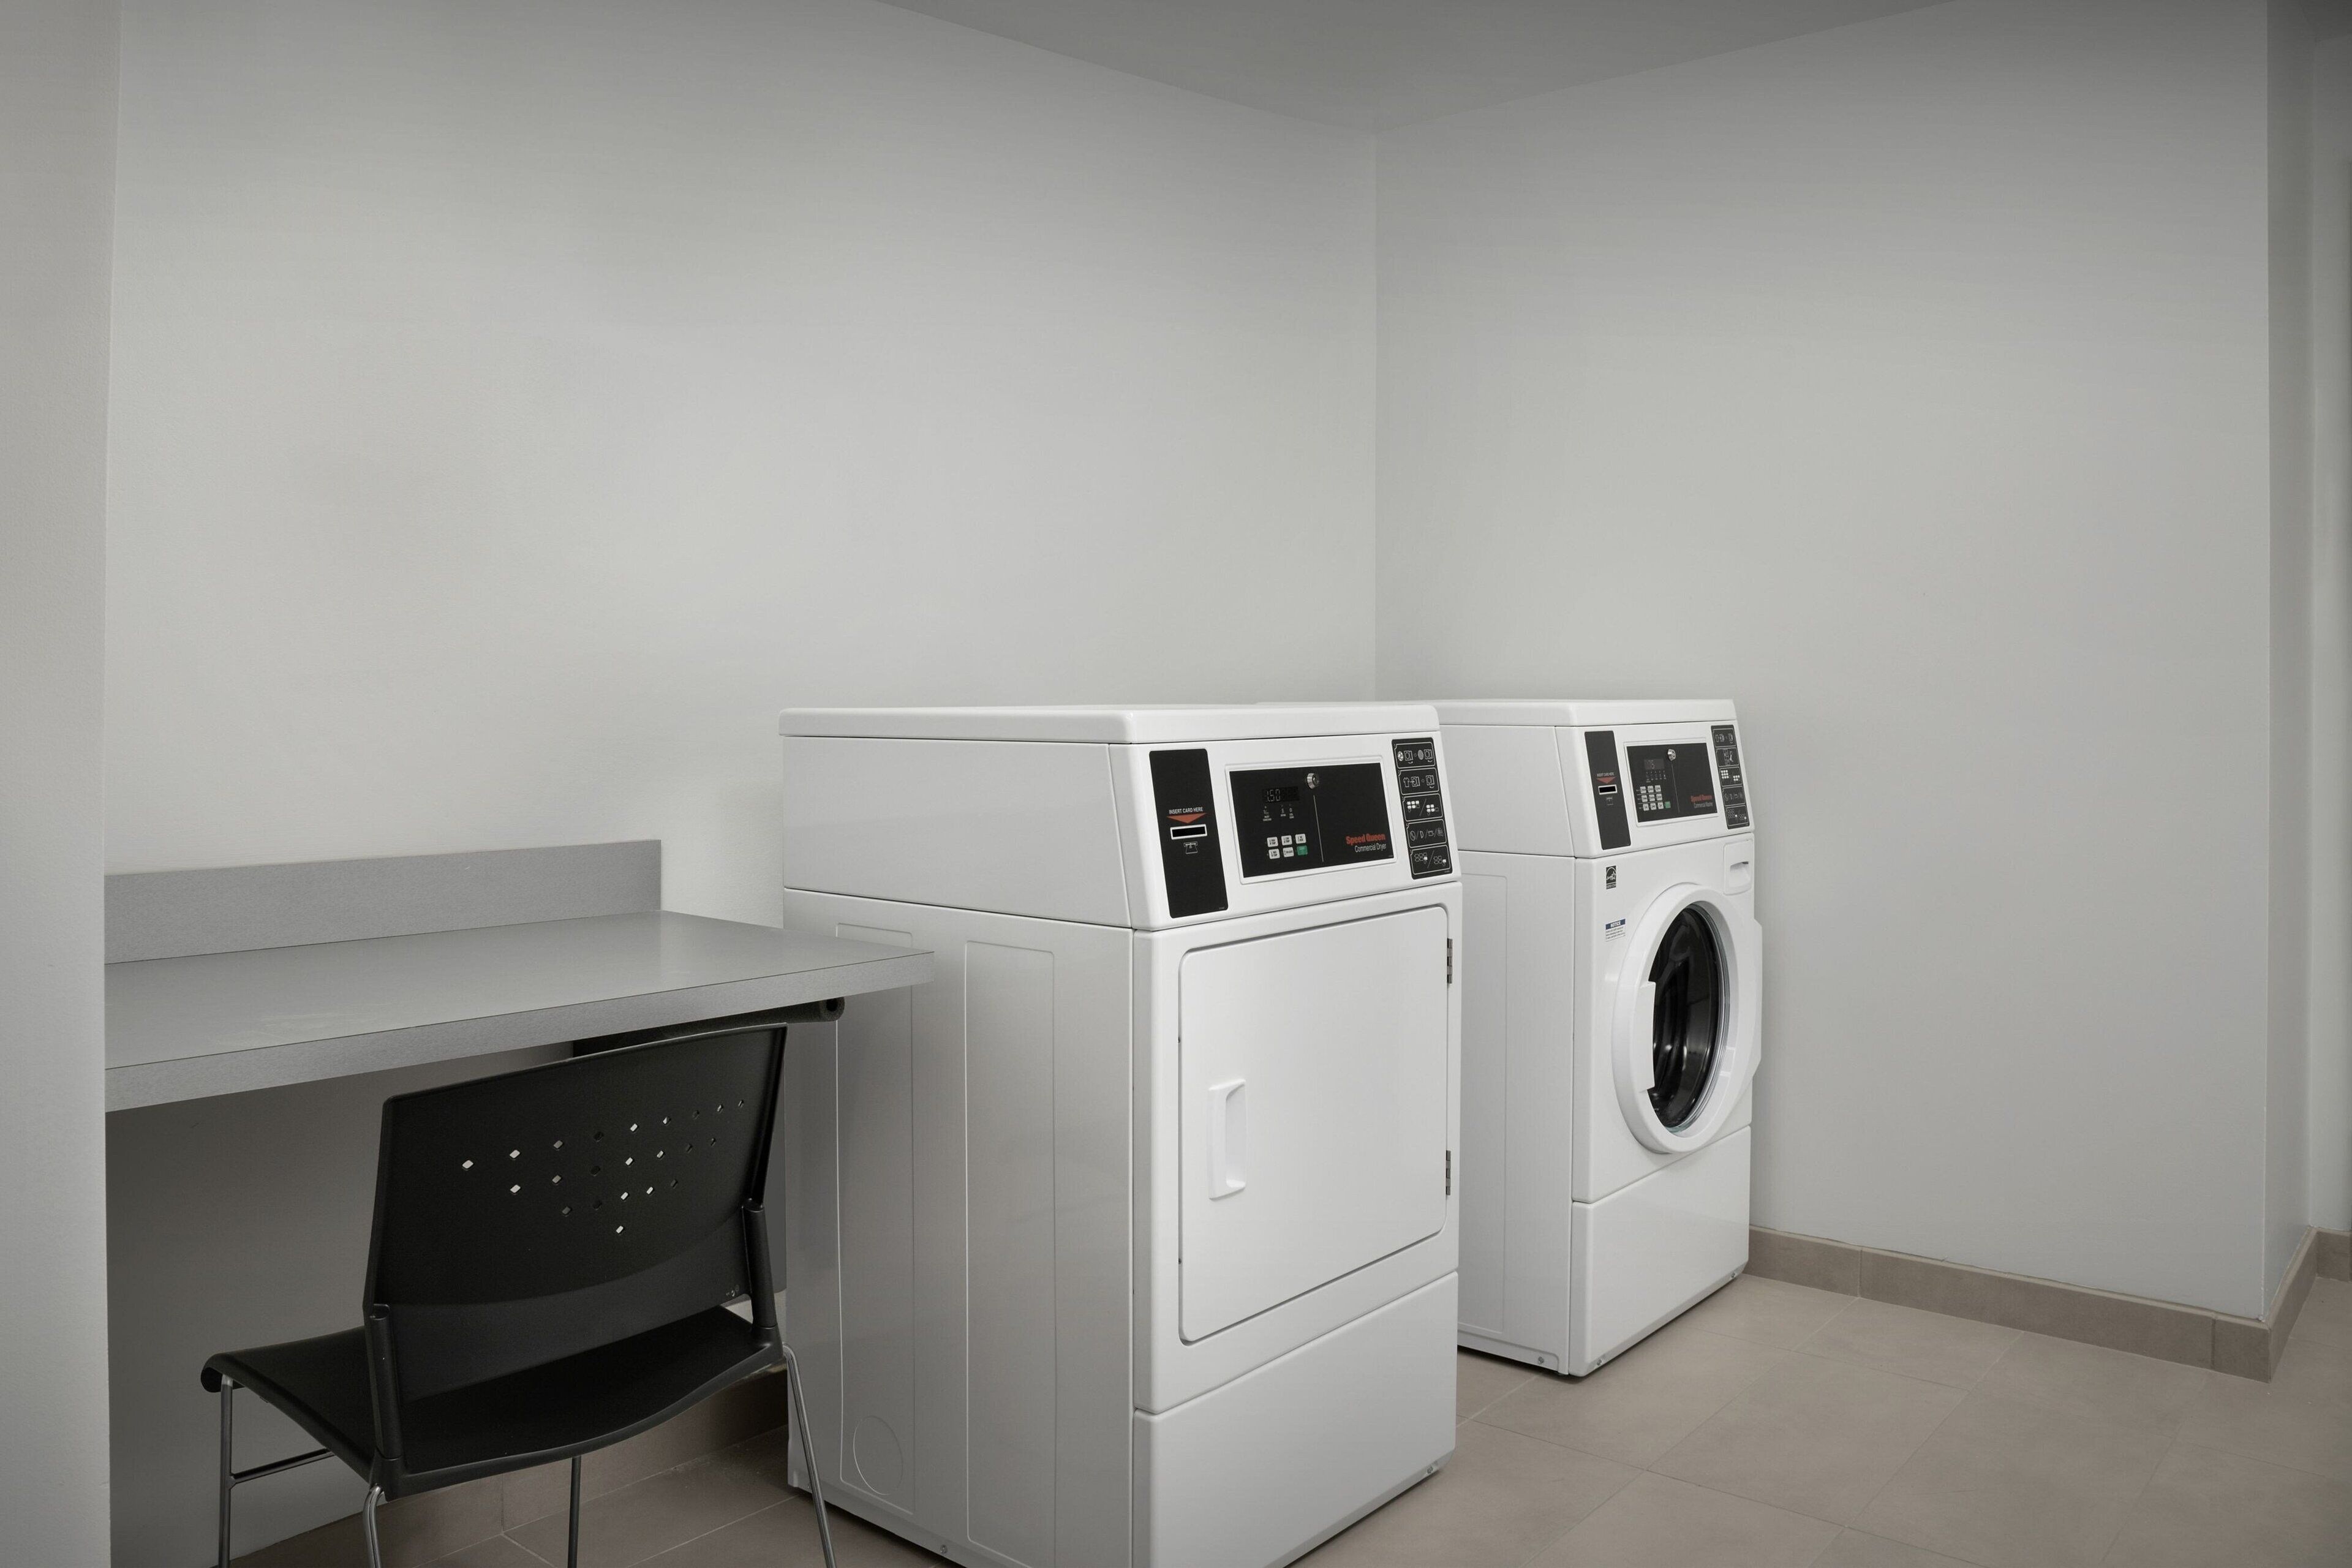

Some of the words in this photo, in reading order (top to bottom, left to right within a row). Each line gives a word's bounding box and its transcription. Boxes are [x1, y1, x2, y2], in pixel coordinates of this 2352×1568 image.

[1346, 834, 1366, 845] Speed
[1366, 833, 1385, 842] Queen
[1354, 843, 1376, 853] Commercial
[1376, 842, 1387, 851] Dryer
